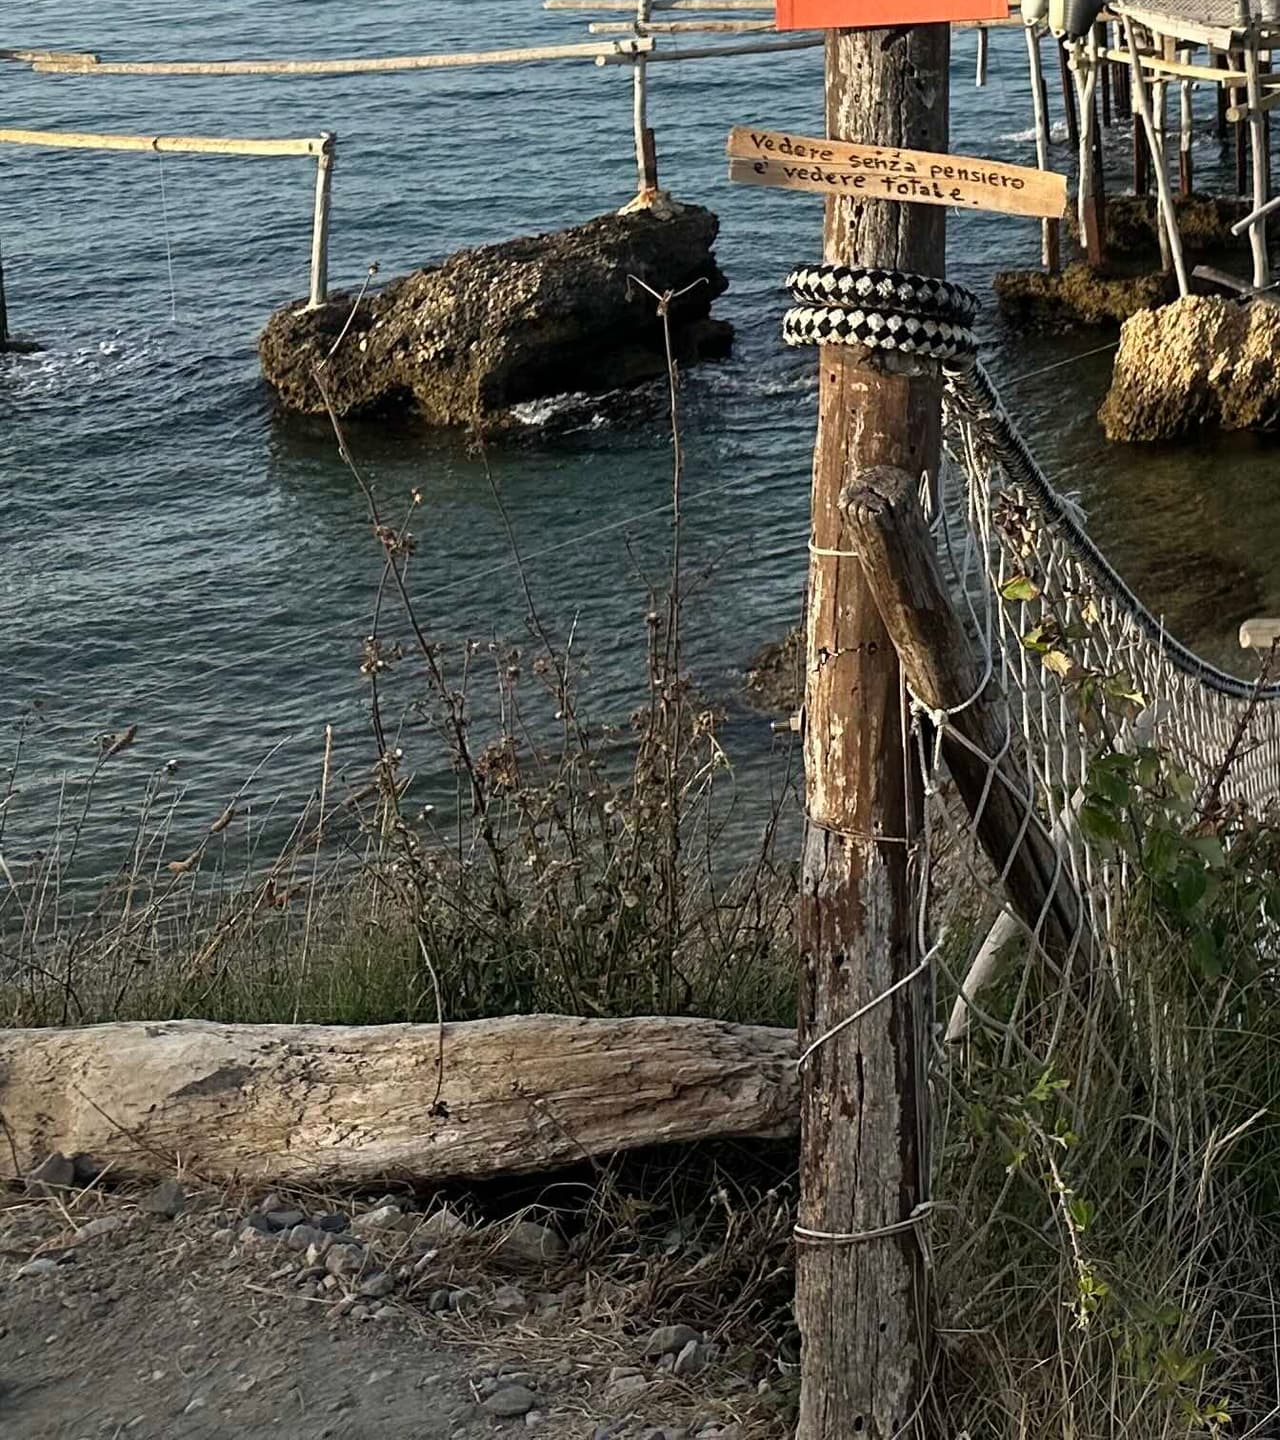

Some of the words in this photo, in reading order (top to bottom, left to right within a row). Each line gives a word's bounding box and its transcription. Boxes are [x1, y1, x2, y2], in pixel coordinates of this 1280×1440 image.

[750, 134, 834, 161] Vedere
[849, 153, 917, 173] senza
[930, 165, 1025, 189] pensiero
[783, 165, 864, 188] vedere
